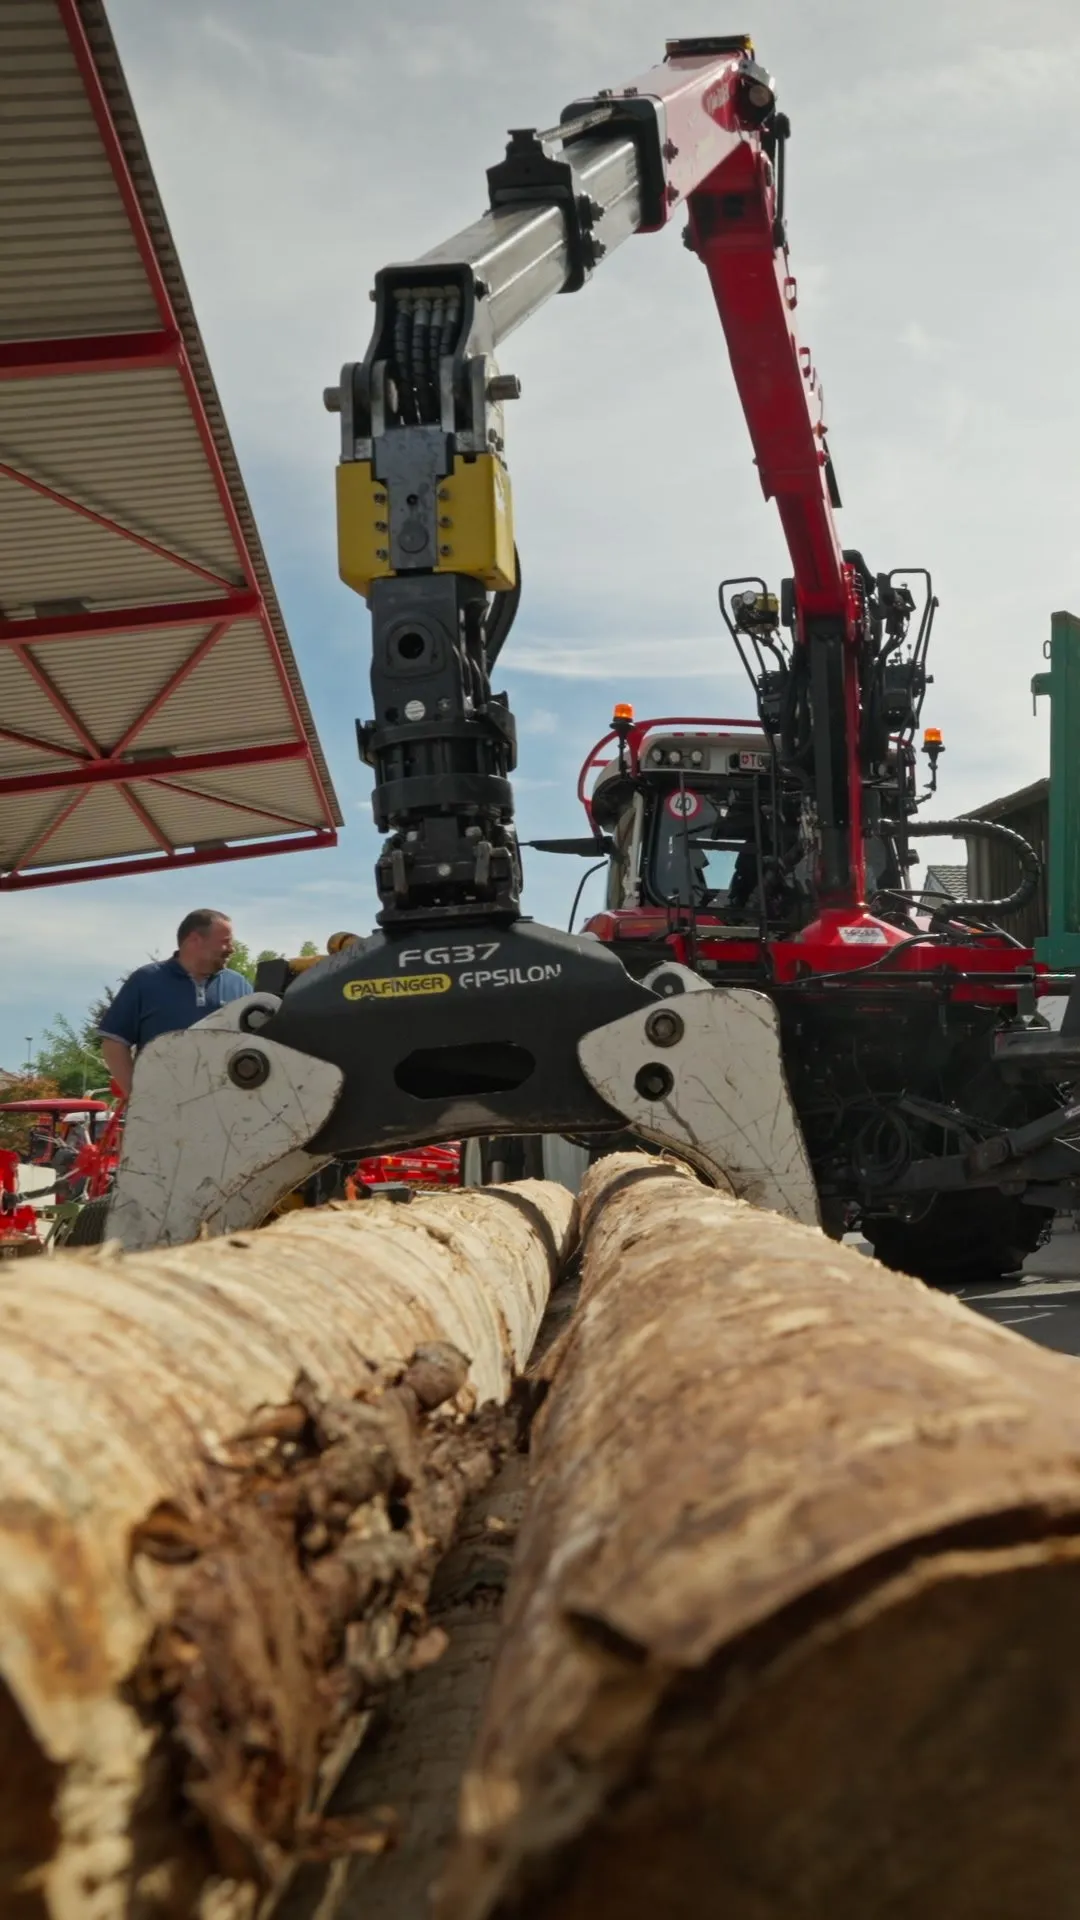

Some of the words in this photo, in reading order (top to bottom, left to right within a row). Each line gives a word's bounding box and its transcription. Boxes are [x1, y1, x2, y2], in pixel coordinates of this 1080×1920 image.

[675, 797, 692, 811] 40
[399, 942, 500, 967] FG37
[350, 977, 444, 996] PALFINGER
[459, 963, 562, 989] EPSILON
